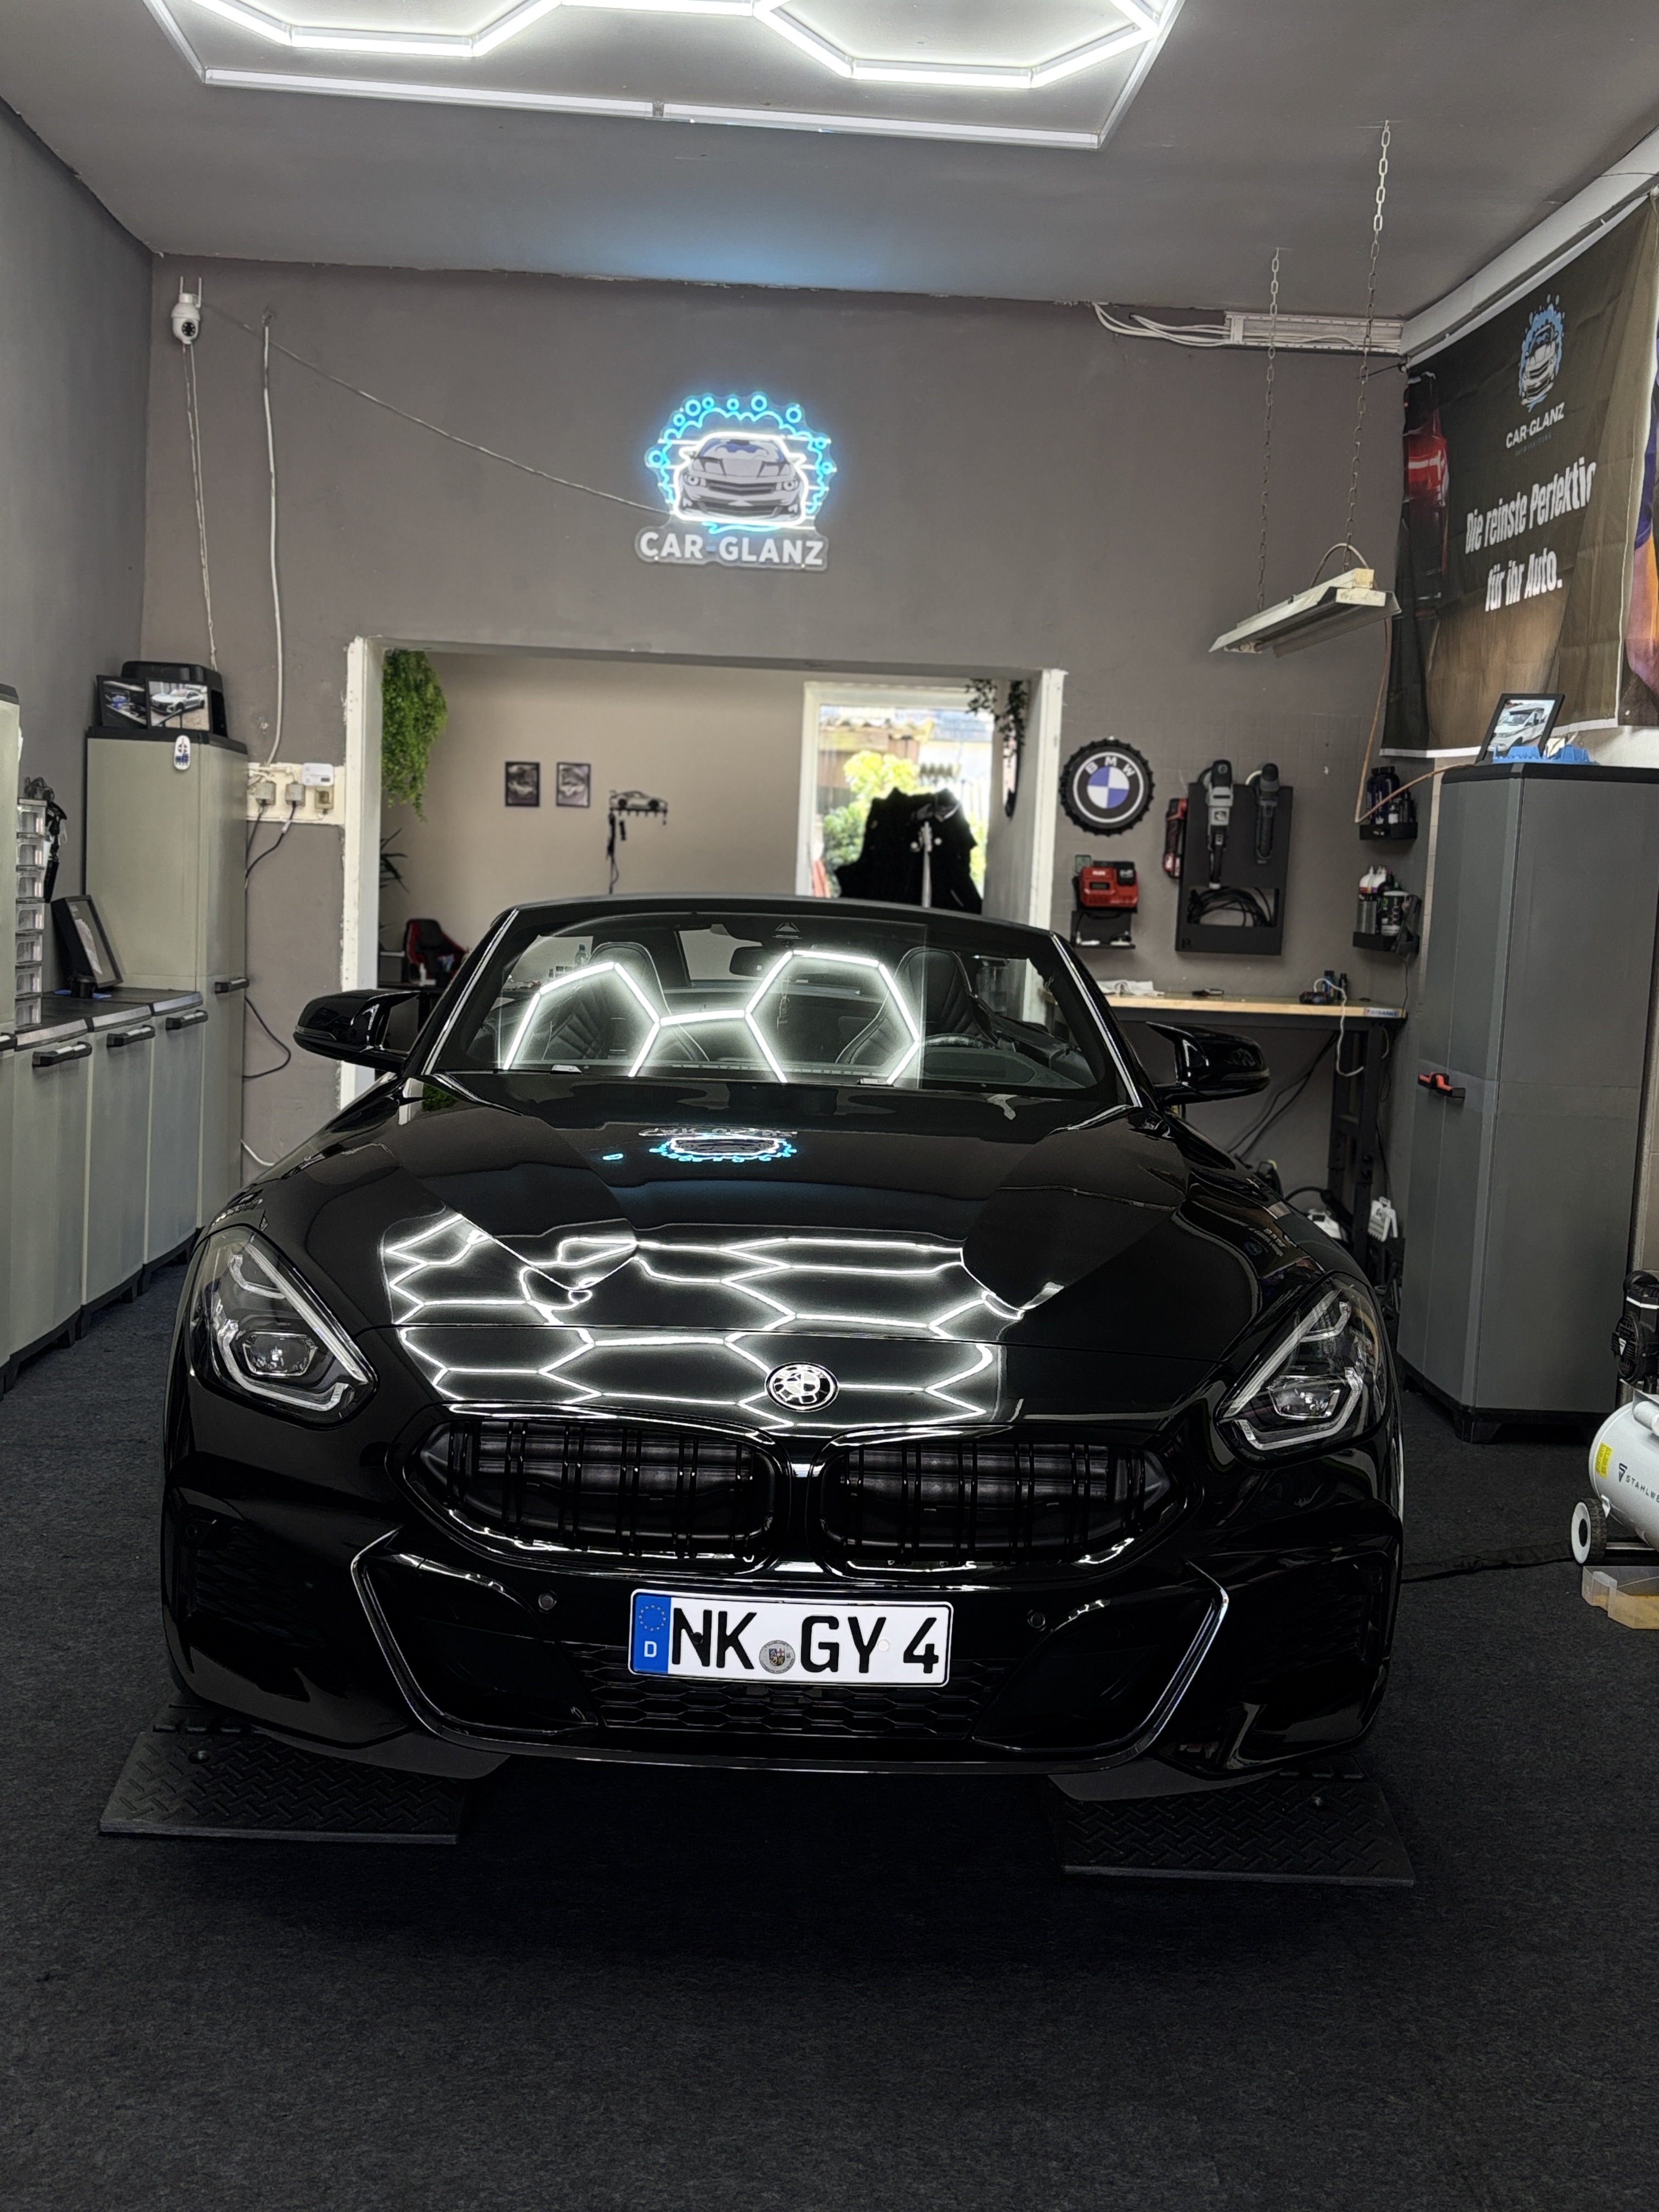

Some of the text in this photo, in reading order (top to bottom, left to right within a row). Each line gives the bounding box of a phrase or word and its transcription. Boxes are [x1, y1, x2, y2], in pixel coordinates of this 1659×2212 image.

[1506, 402, 1565, 448] CAR-GLANZ
[1465, 509, 1483, 554] Die
[1484, 492, 1527, 548] reinste
[640, 532, 823, 565] CAR-GLANZ
[1485, 548, 1562, 612] für ihr Auto.
[1085, 756, 1135, 777] BMW
[644, 1640, 657, 1658] D
[672, 1607, 757, 1670] NK
[800, 1615, 887, 1673] GY
[902, 1617, 939, 1674] 4
